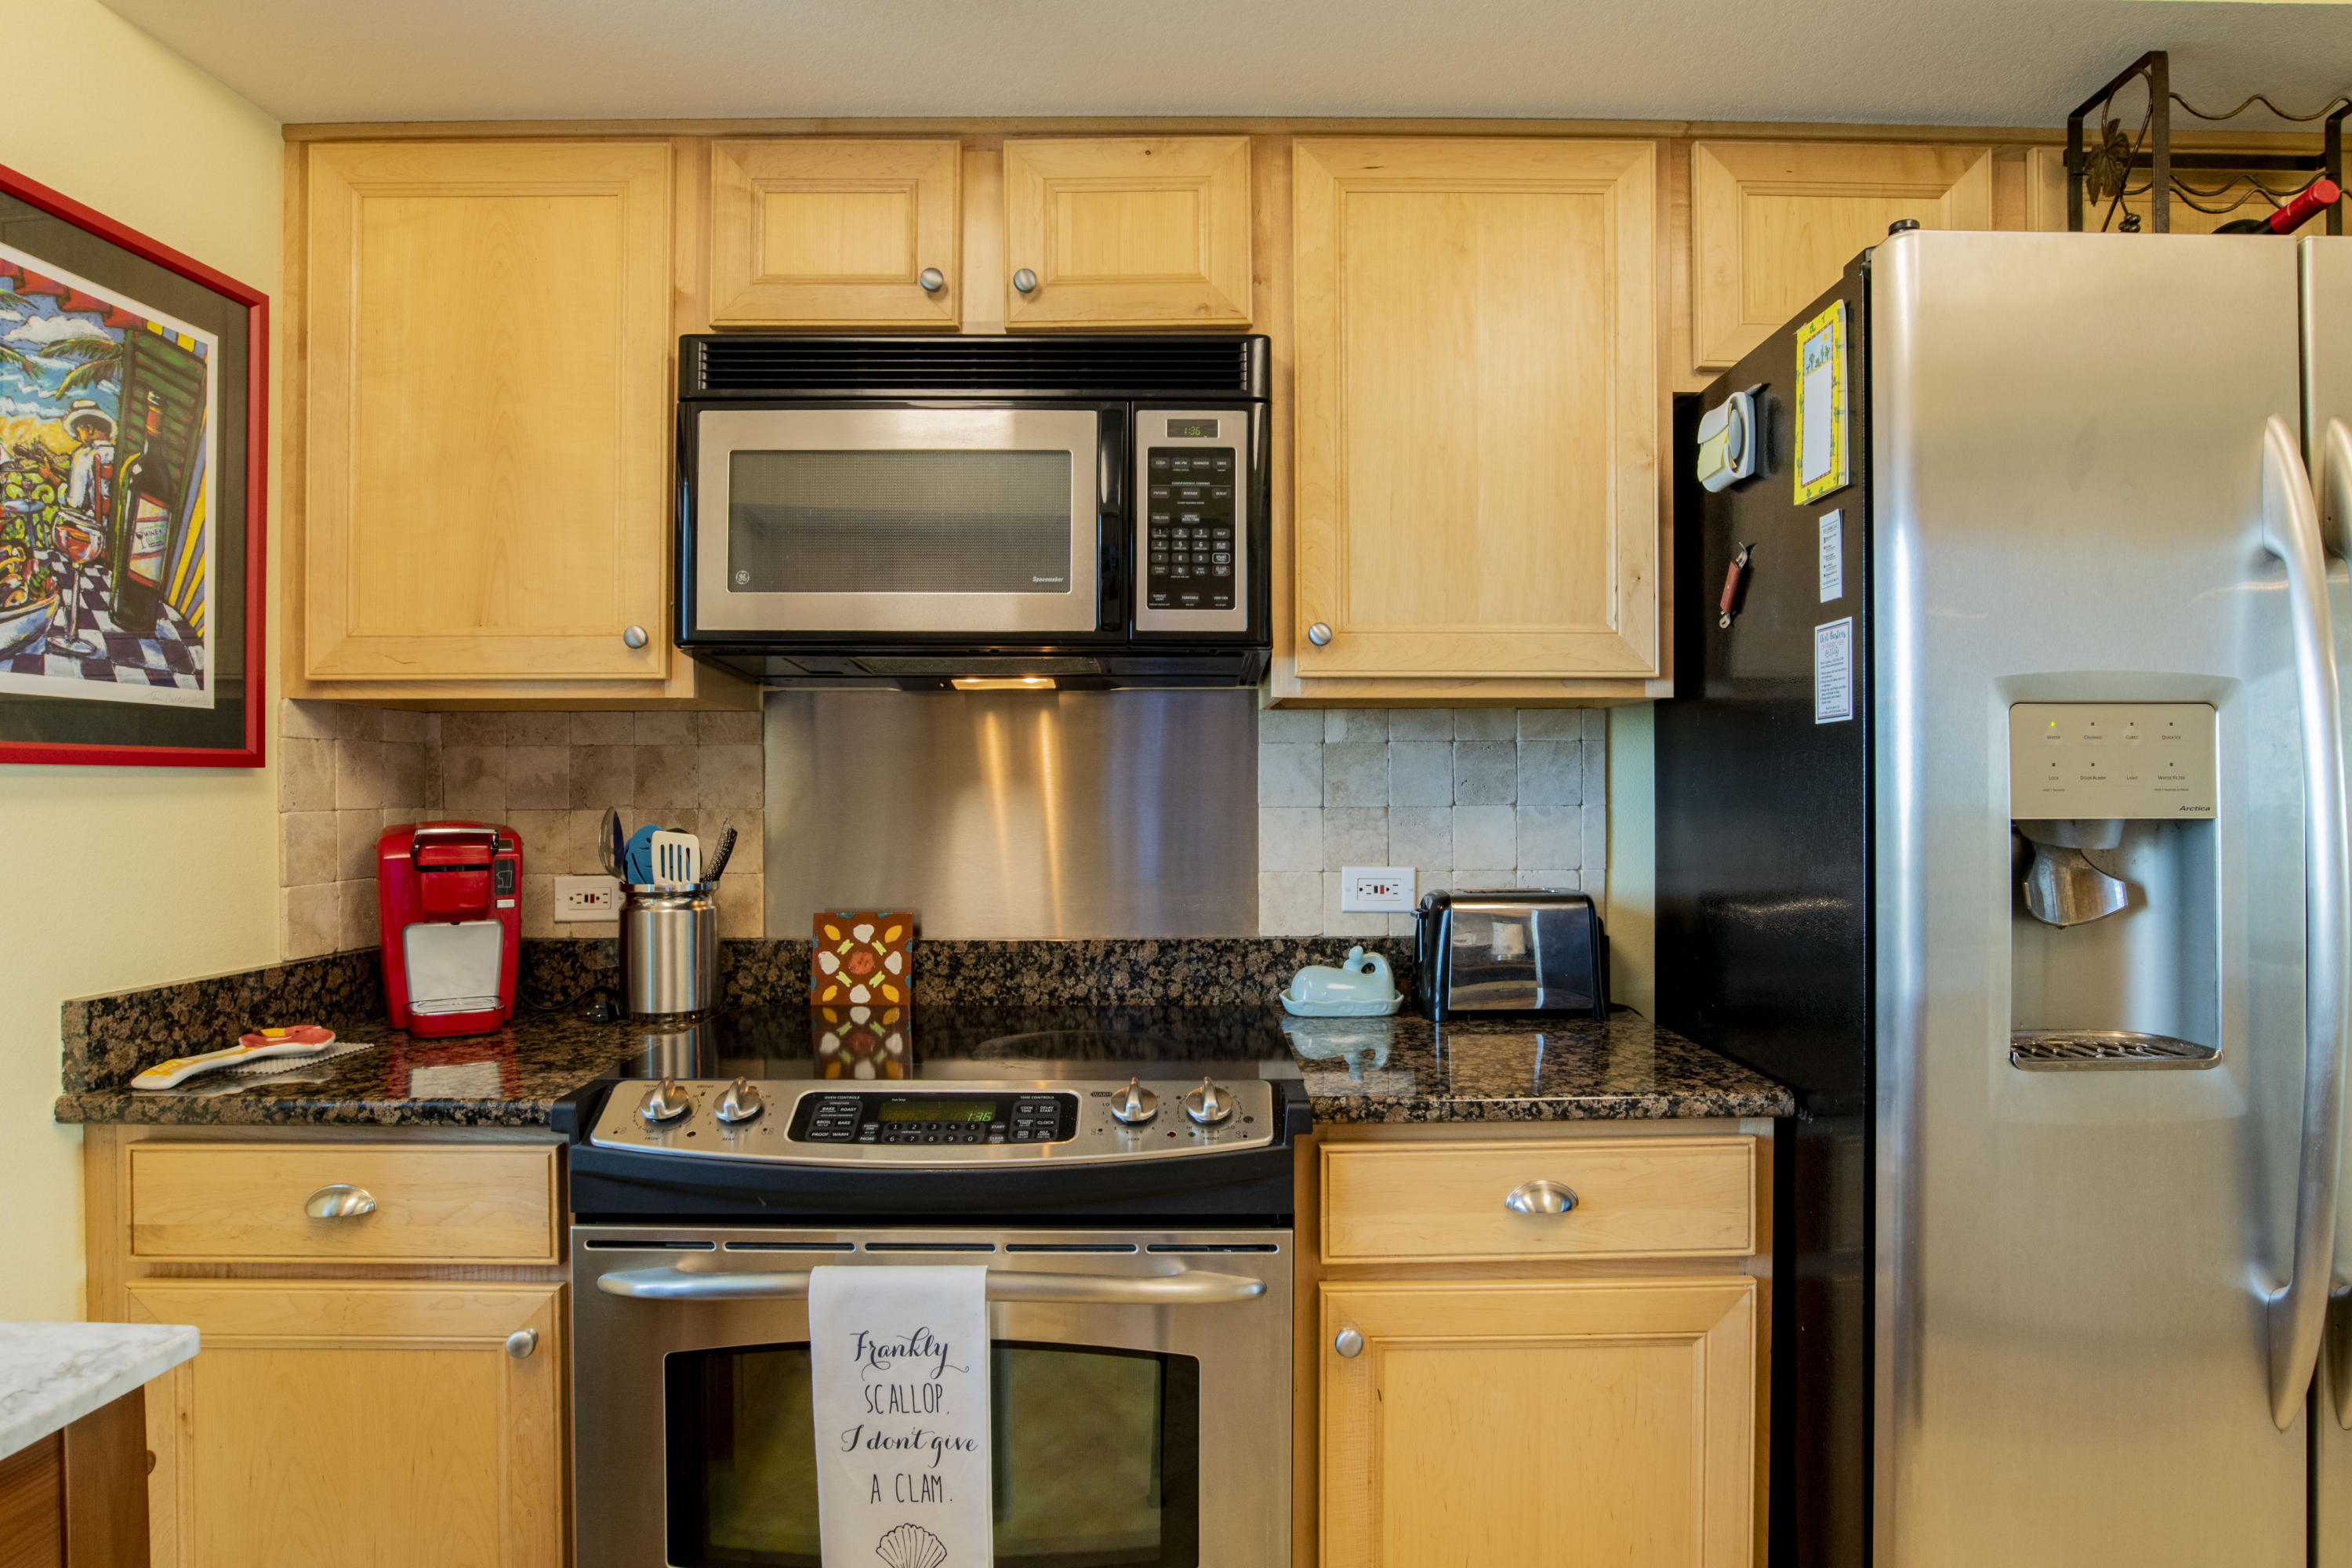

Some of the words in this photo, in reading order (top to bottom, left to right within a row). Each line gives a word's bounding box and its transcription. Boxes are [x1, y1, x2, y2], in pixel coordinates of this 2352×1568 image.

[1185, 426, 1200, 435] 1:36
[967, 1112, 992, 1121] 1:36
[850, 1327, 969, 1381] Frankly
[841, 1424, 864, 1452] I
[928, 1435, 978, 1468] give
[871, 1474, 881, 1504] A
[895, 1473, 953, 1504] CLAM.
